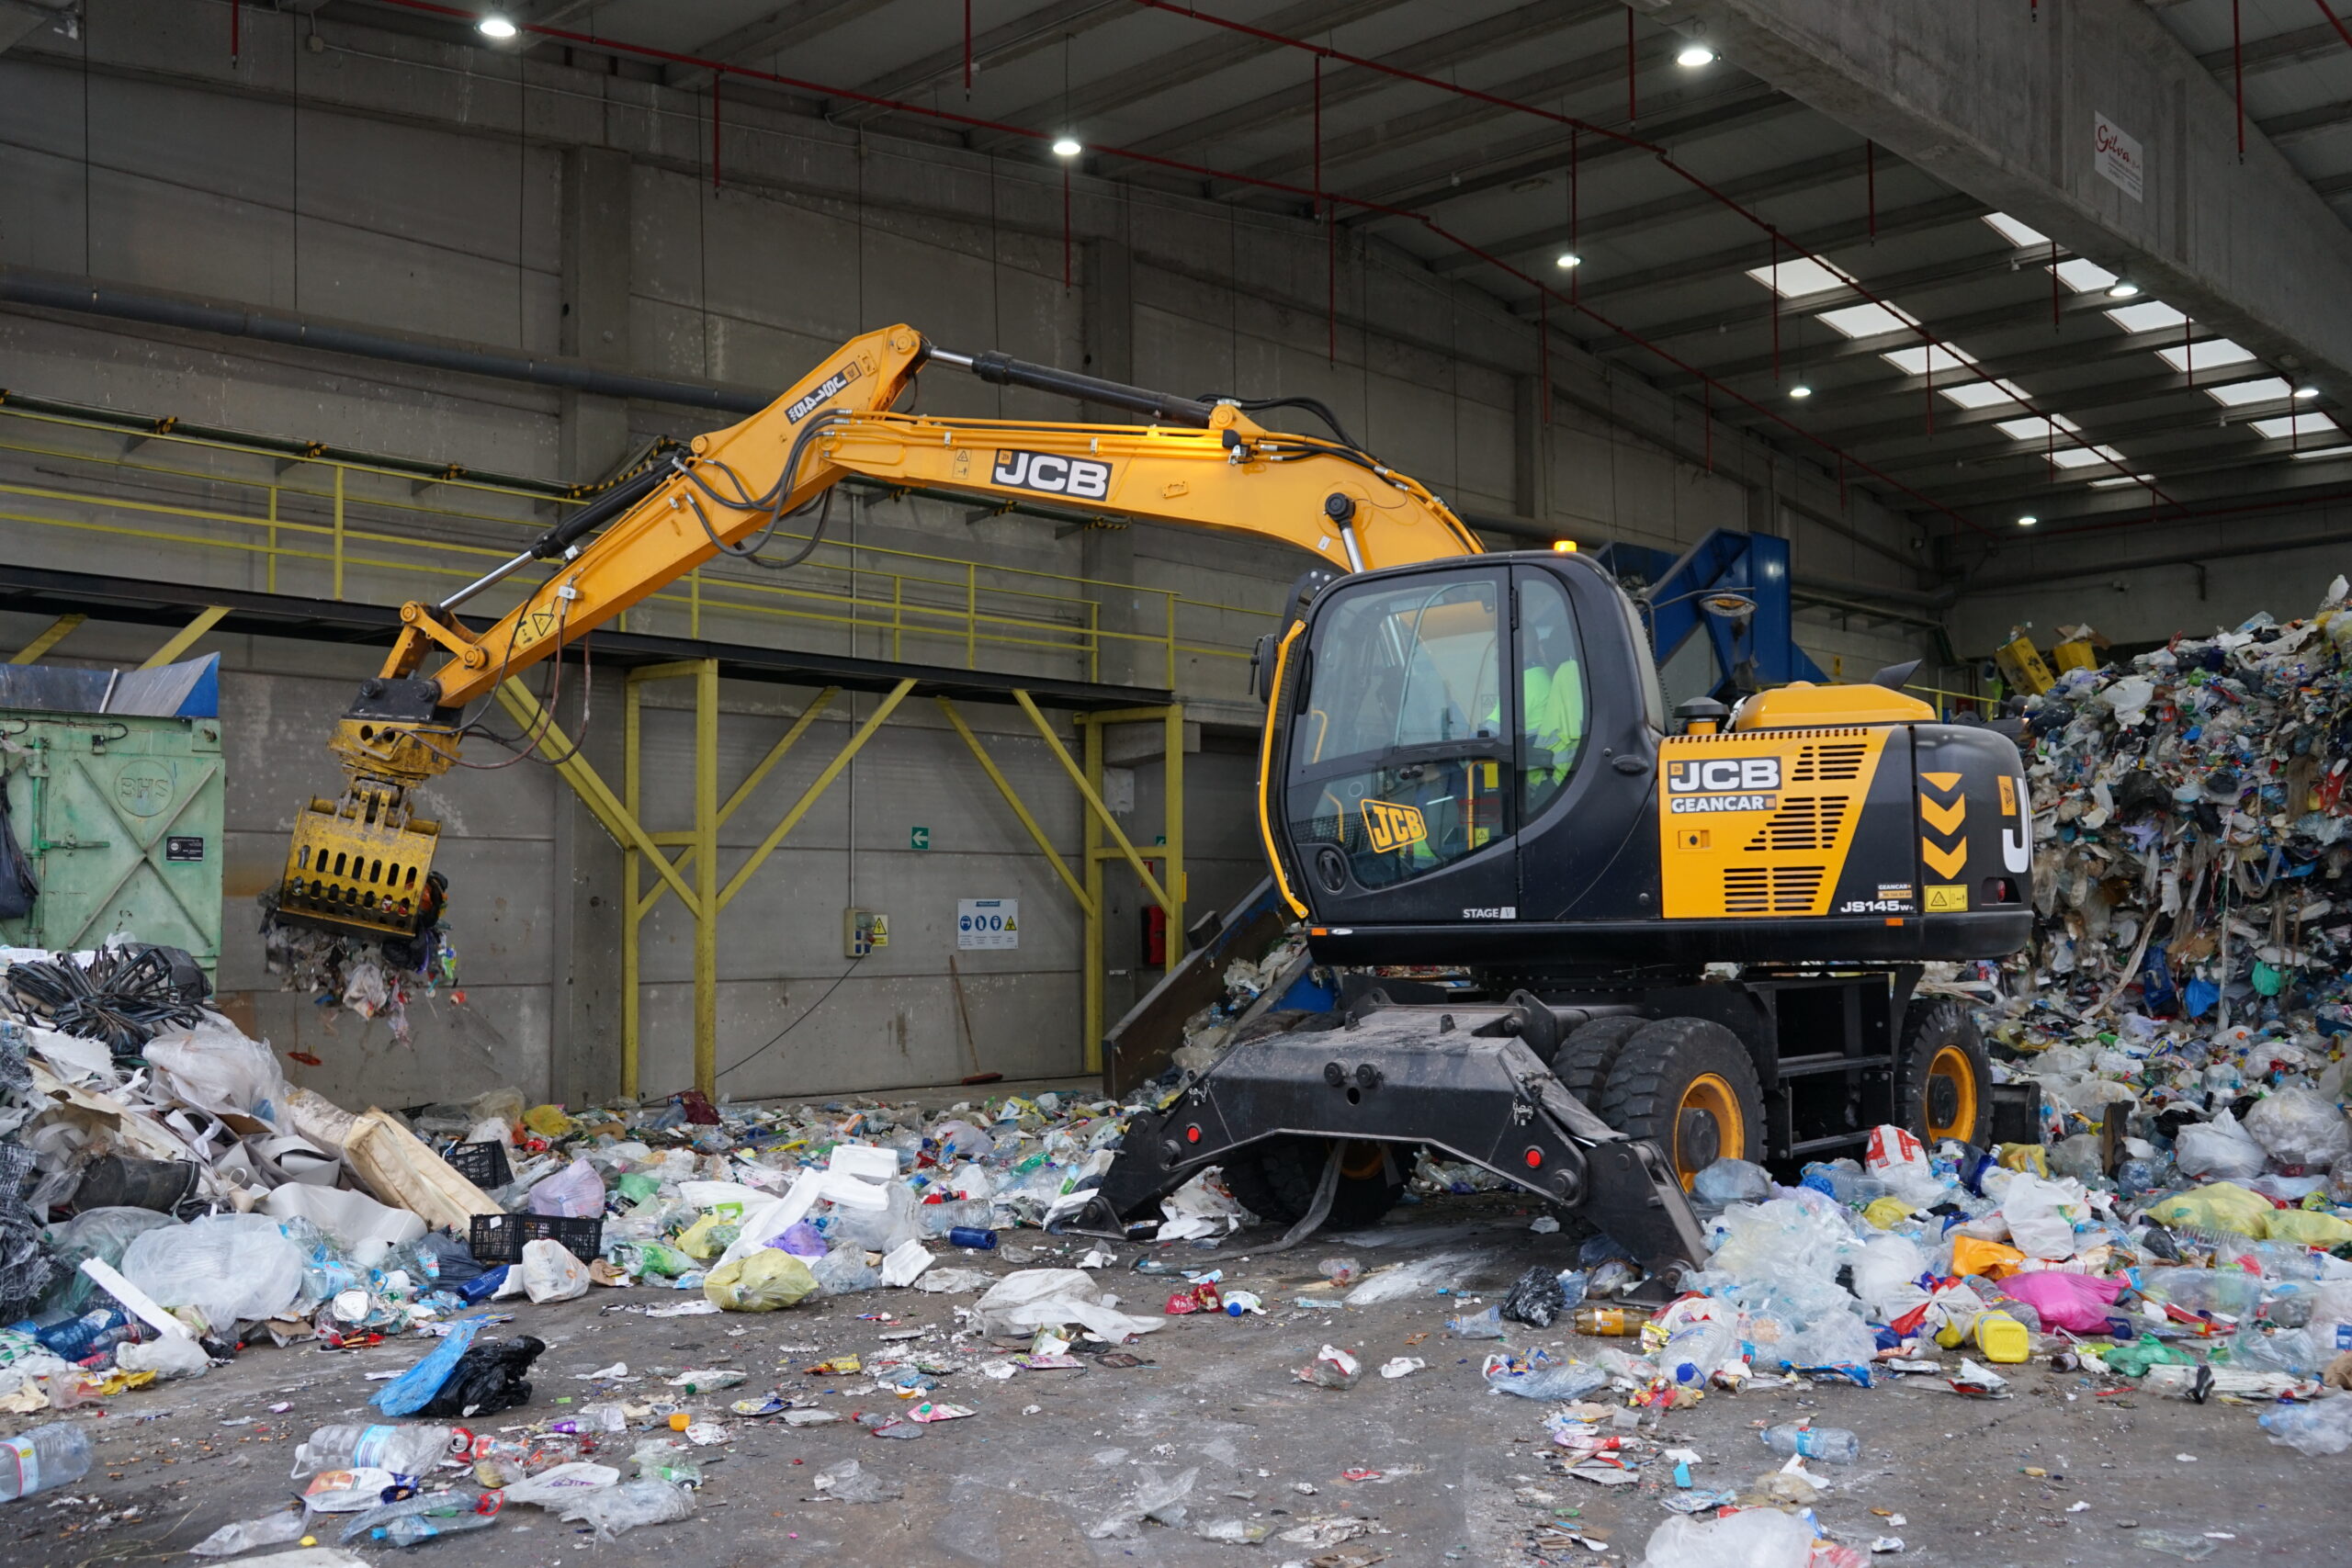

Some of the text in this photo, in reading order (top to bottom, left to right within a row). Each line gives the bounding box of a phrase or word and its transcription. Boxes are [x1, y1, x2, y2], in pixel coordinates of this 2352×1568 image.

[995, 452, 1108, 497] JCB
[120, 777, 169, 798] BHS
[1670, 760, 1780, 792] JCB
[1672, 795, 1764, 813] GEANCAR
[1373, 805, 1423, 847] JCB
[1463, 908, 1499, 919] STAGE
